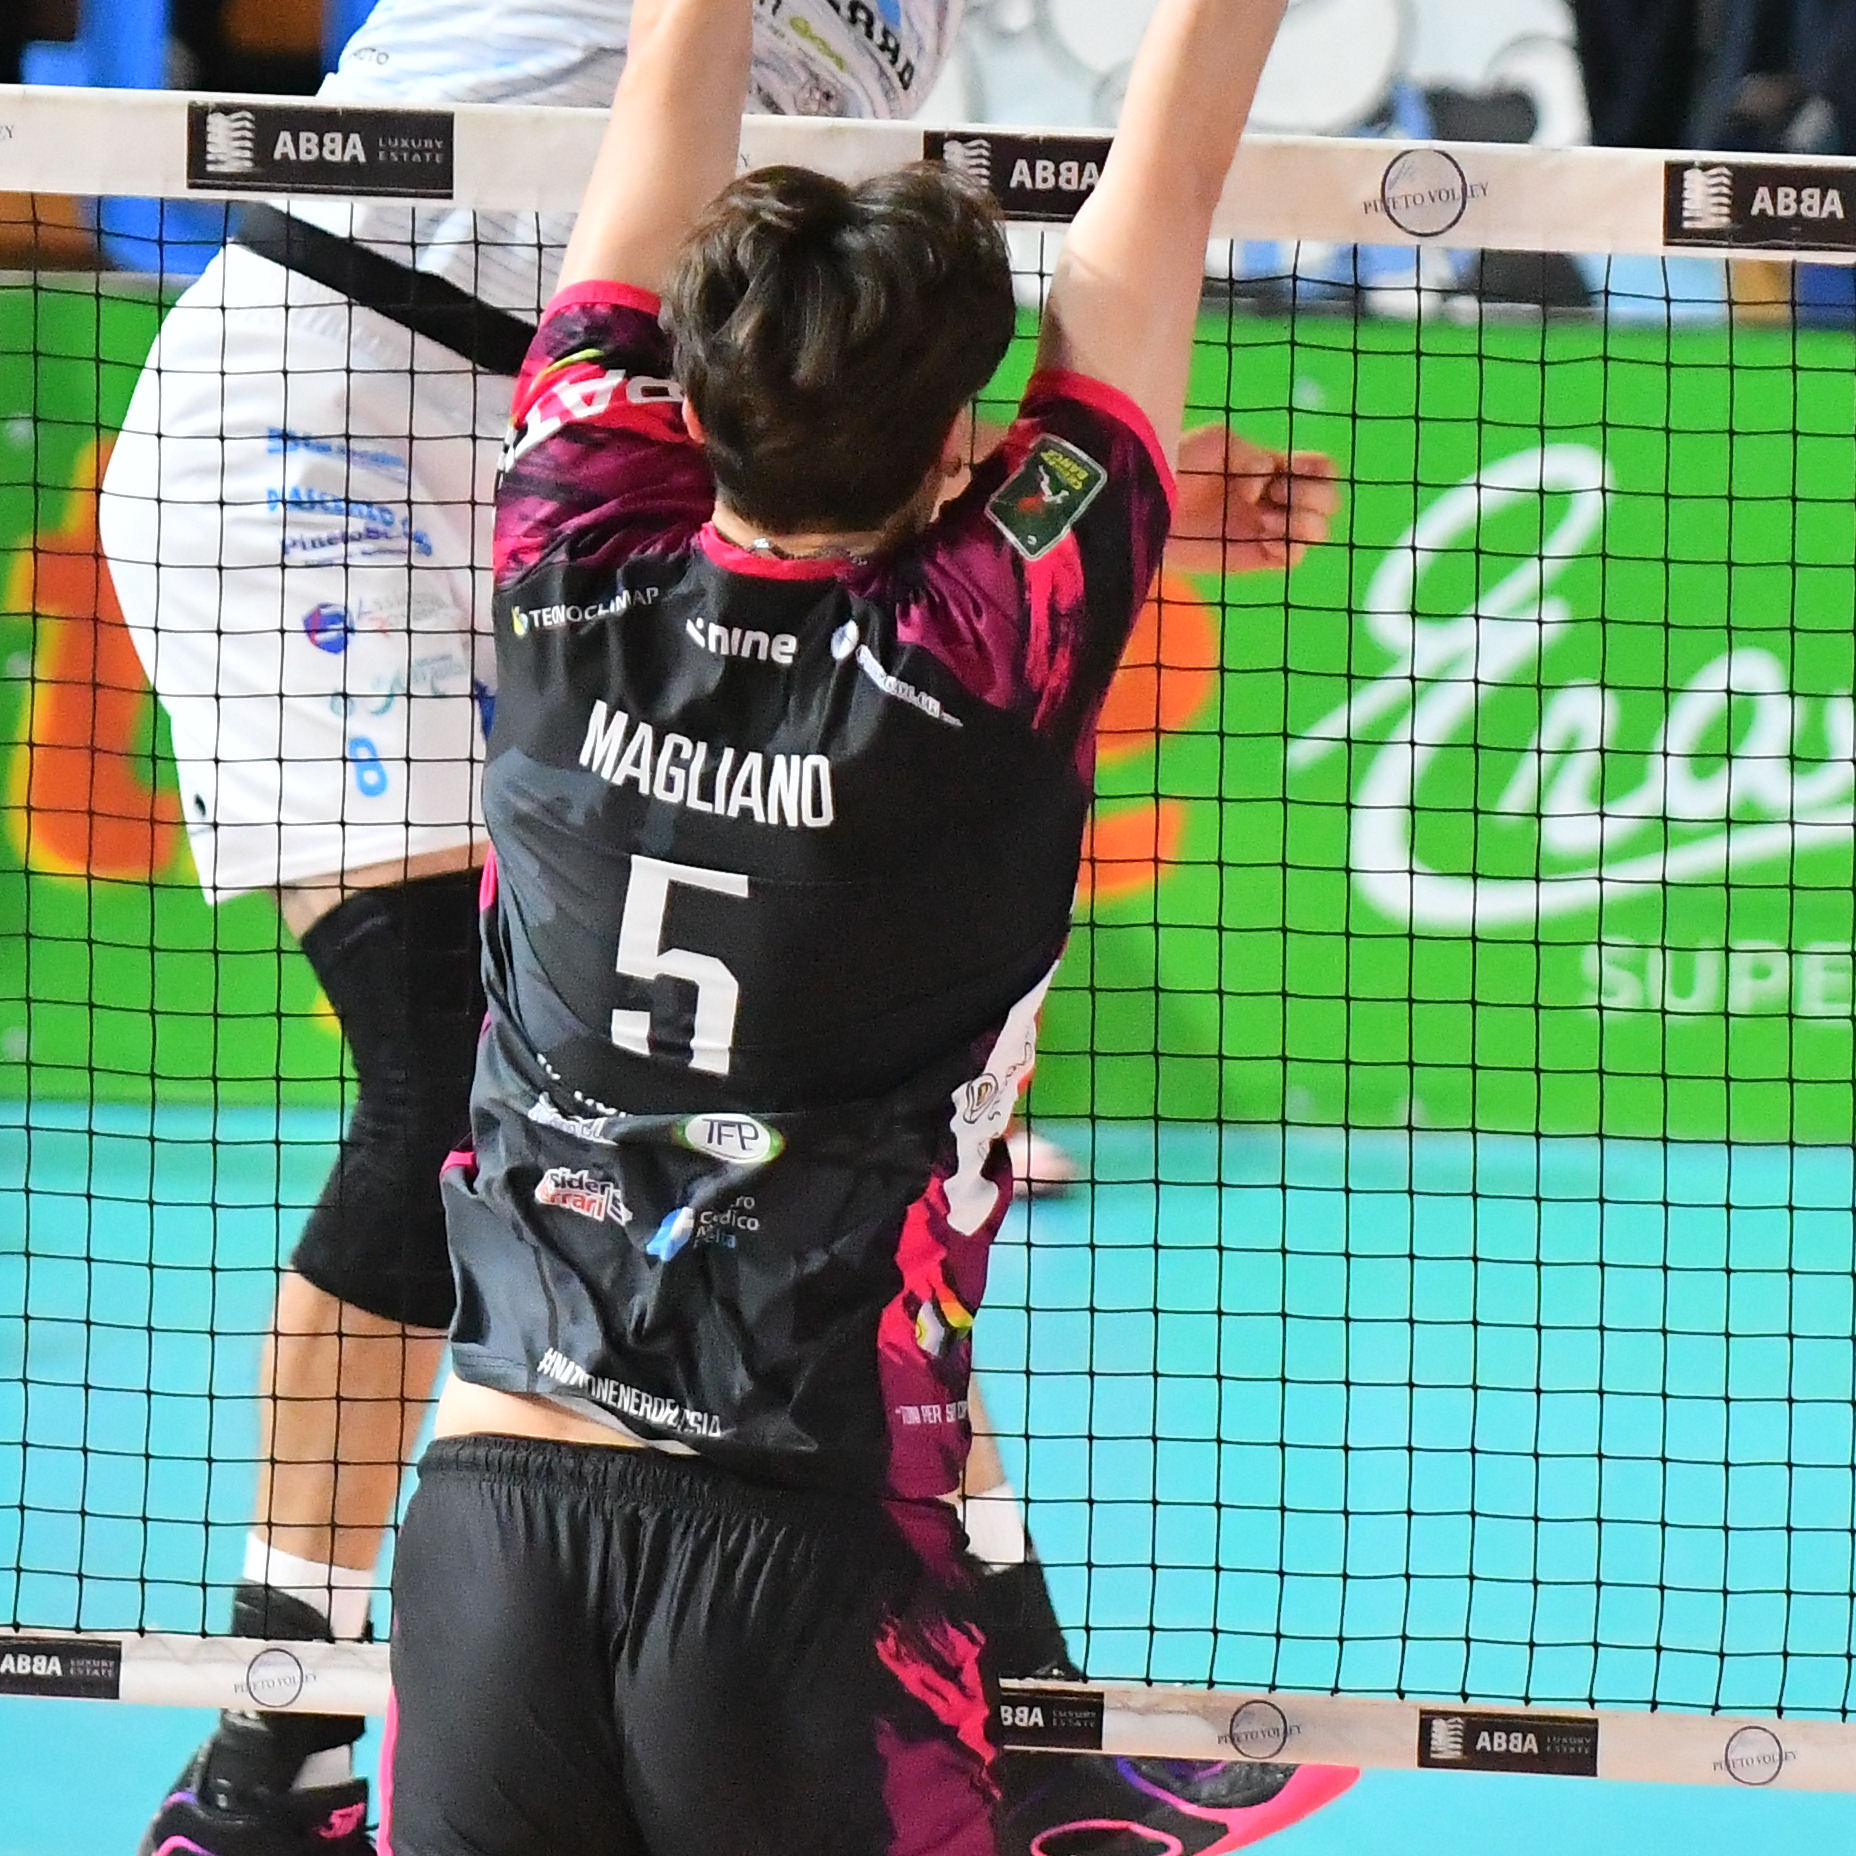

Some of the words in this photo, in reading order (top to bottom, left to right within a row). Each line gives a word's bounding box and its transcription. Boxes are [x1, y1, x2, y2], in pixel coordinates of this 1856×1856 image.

[273, 130, 366, 165] ABBA
[1009, 157, 1101, 193] ABBA
[1750, 185, 1845, 220] ABBA
[708, 621, 799, 665] nine
[348, 736, 389, 798] 8
[579, 699, 835, 830] MAGLIANO
[611, 853, 749, 1076] 5
[702, 1117, 760, 1151] TFP
[0, 1653, 63, 1677] ABBA
[999, 1705, 1044, 1728] BBA
[1475, 1731, 1539, 1754] ABBA
